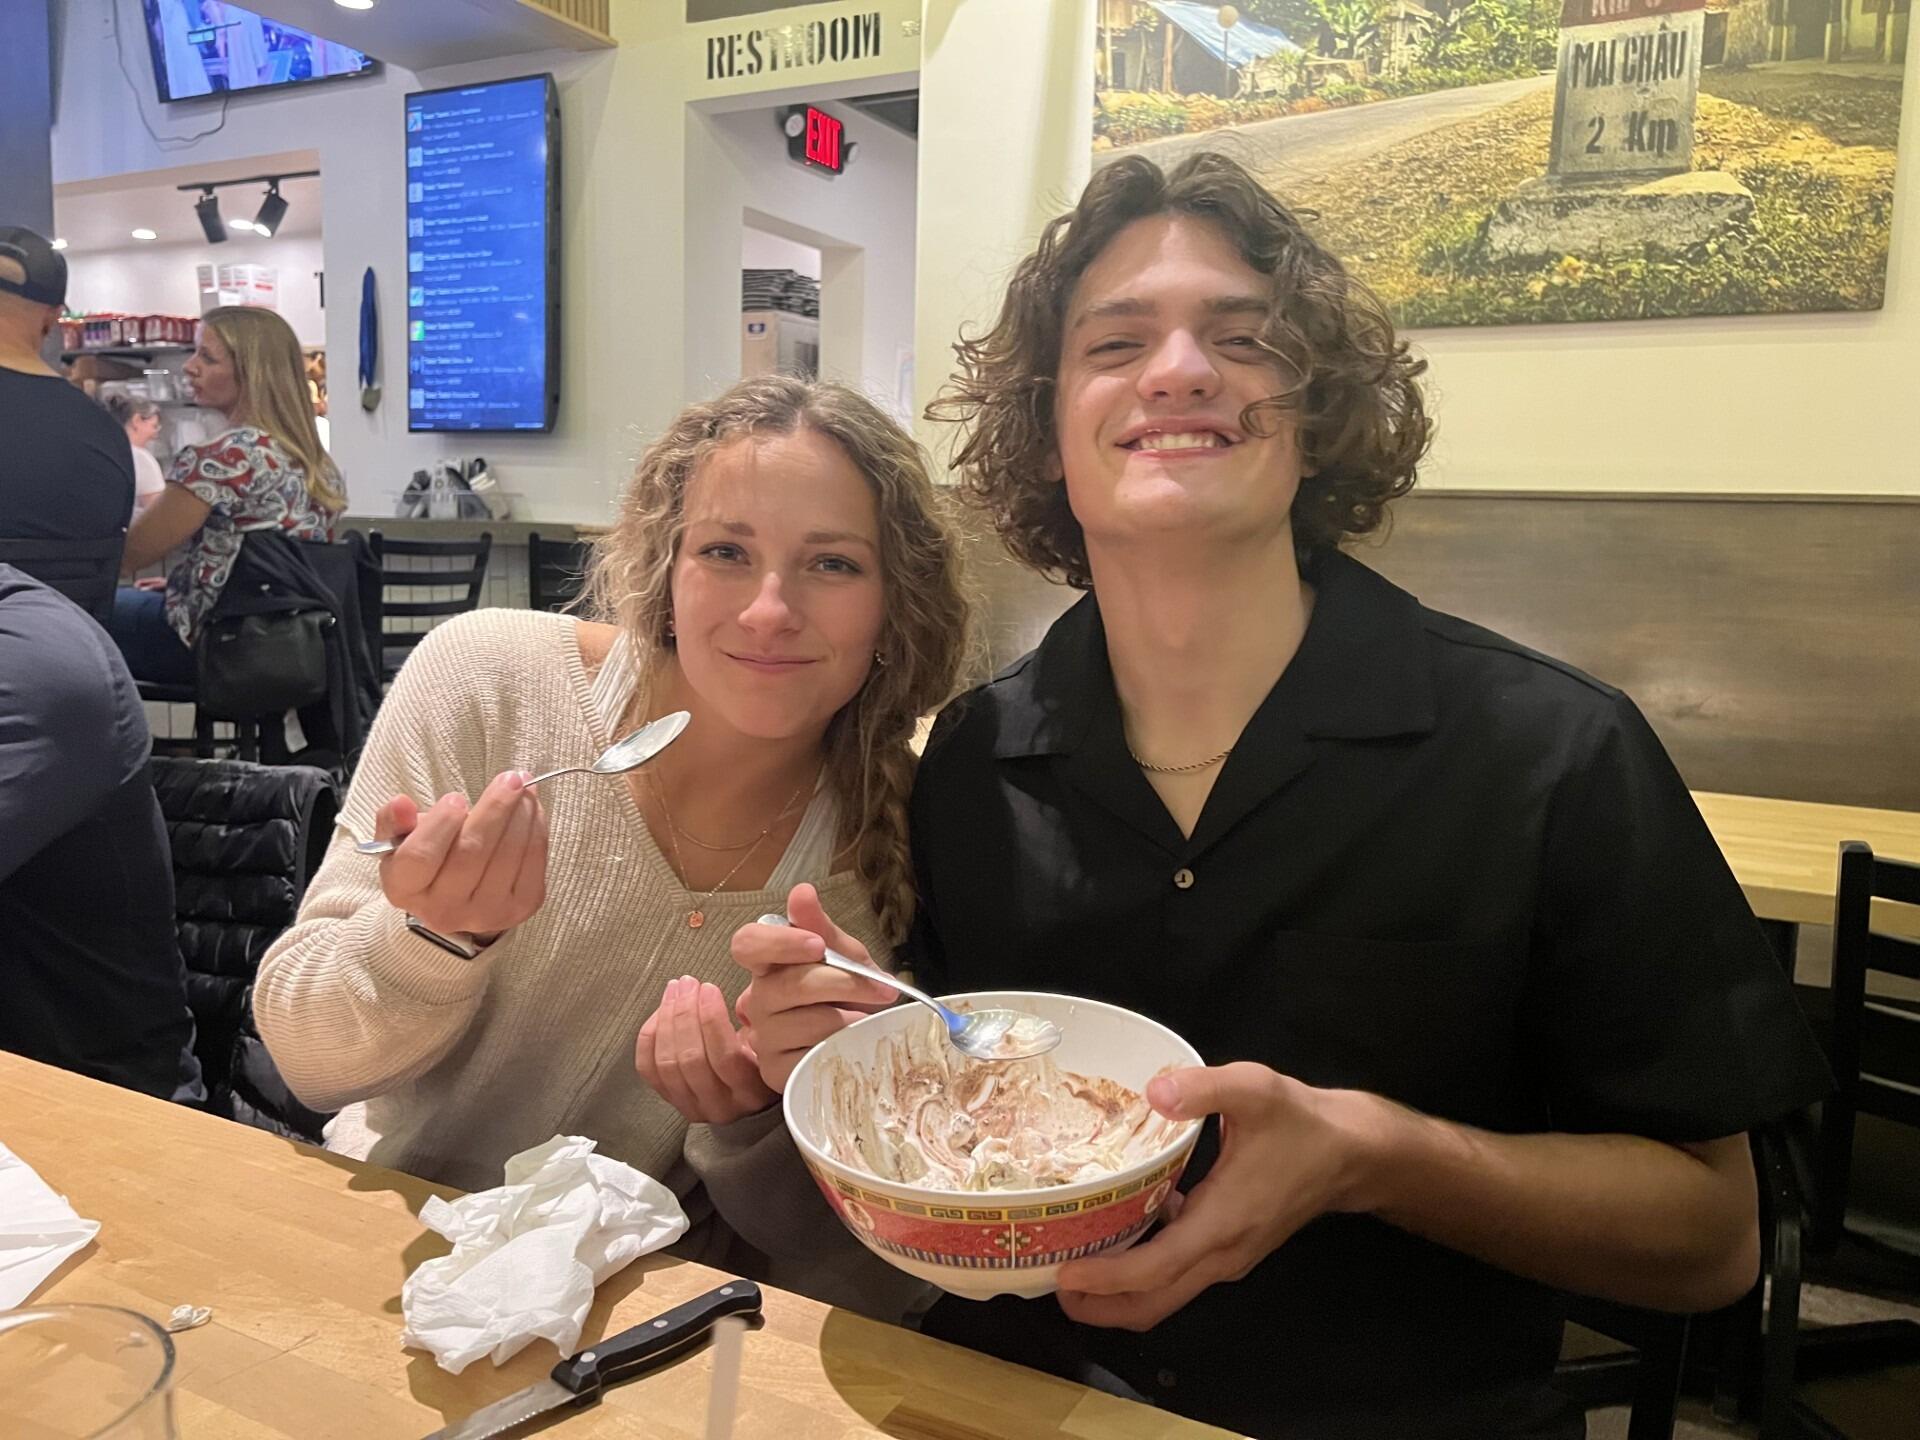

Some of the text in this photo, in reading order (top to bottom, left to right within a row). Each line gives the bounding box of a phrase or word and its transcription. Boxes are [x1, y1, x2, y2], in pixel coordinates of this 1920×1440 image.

[706, 12, 881, 80] RESTROOM
[1572, 38, 1617, 89] MAI
[805, 106, 842, 170] EXIT
[1585, 116, 1606, 154] 2
